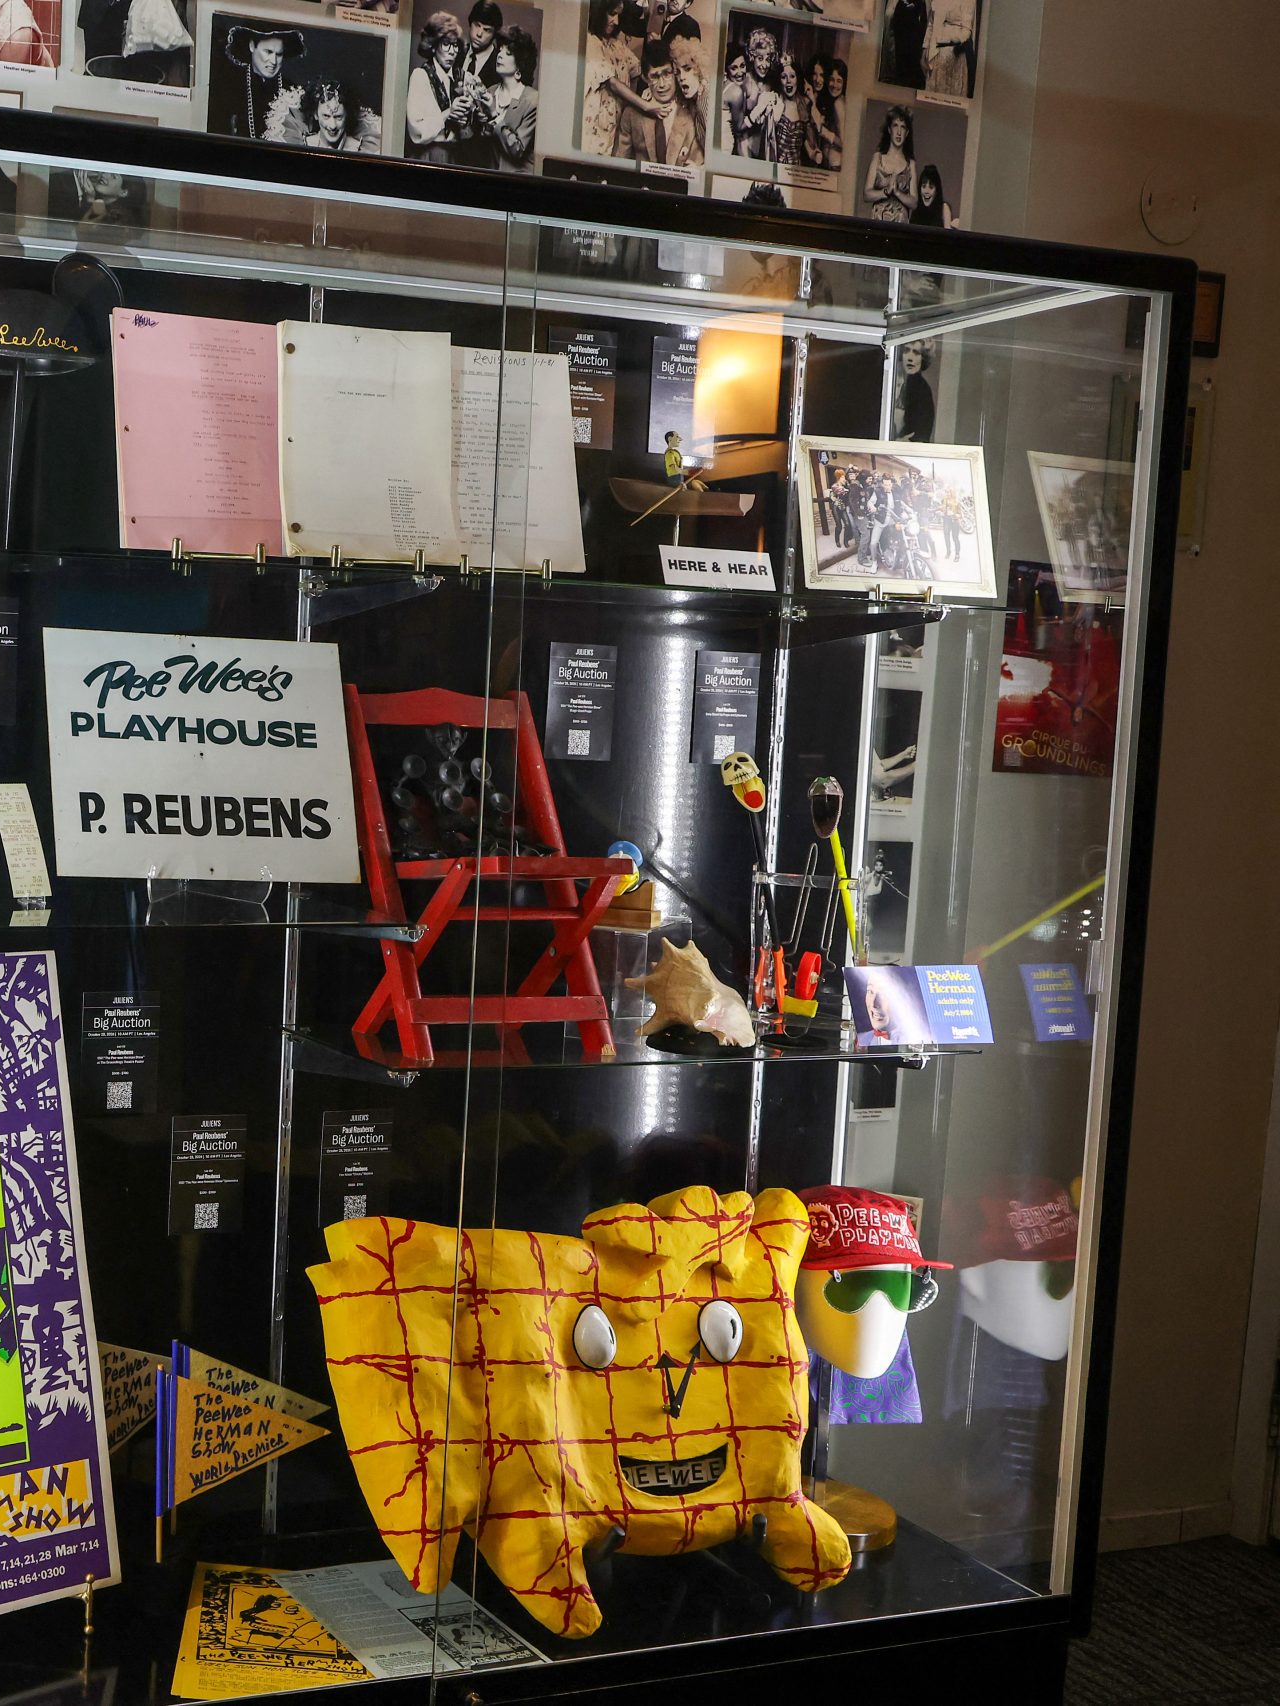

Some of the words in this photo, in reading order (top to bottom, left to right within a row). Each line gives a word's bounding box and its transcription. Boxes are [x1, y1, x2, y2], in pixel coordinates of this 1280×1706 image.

[575, 333, 594, 342] JULIEN'S
[567, 344, 579, 353] Paul
[573, 353, 609, 367] Auction
[670, 354, 681, 362] Paul
[661, 361, 675, 375] Big
[667, 559, 708, 573] HERE
[711, 561, 721, 573] &
[727, 563, 769, 576] HEAR
[567, 659, 579, 667] Paul
[558, 666, 573, 680] Big
[573, 667, 608, 680] Auction
[713, 667, 724, 675] Paul
[83, 660, 173, 709] Pee
[164, 654, 294, 702] Wee's
[705, 674, 718, 687] Big
[719, 675, 752, 687] Auction
[70, 711, 318, 749] PLAYHOUSE
[1031, 729, 1072, 750] CIRQUE
[1072, 742, 1088, 754] DU
[1001, 734, 1106, 777] GROUNDLINGS
[78, 791, 107, 835] P.
[123, 792, 332, 840] REUBENS
[925, 969, 972, 982] PeeWee
[928, 981, 977, 994] Herman
[112, 996, 134, 1004] JULIEN'S
[104, 1008, 117, 1017] Paul
[116, 1008, 142, 1017] Reubens'
[93, 1017, 110, 1031] Big
[110, 1017, 151, 1028] Auction
[200, 1119, 222, 1128] JULIEN'S
[342, 1126, 354, 1134] Paul
[192, 1132, 204, 1140] Paul
[332, 1134, 347, 1147] Big
[347, 1133, 384, 1145] Auction
[182, 1140, 198, 1154] Big
[198, 1139, 238, 1151] Auction
[101, 1351, 127, 1366] The
[206, 1367, 233, 1381] The
[193, 1391, 224, 1407] The
[9, 1497, 94, 1533] SHOW
[55, 1543, 78, 1558] Mar
[80, 1538, 100, 1553] 7,14
